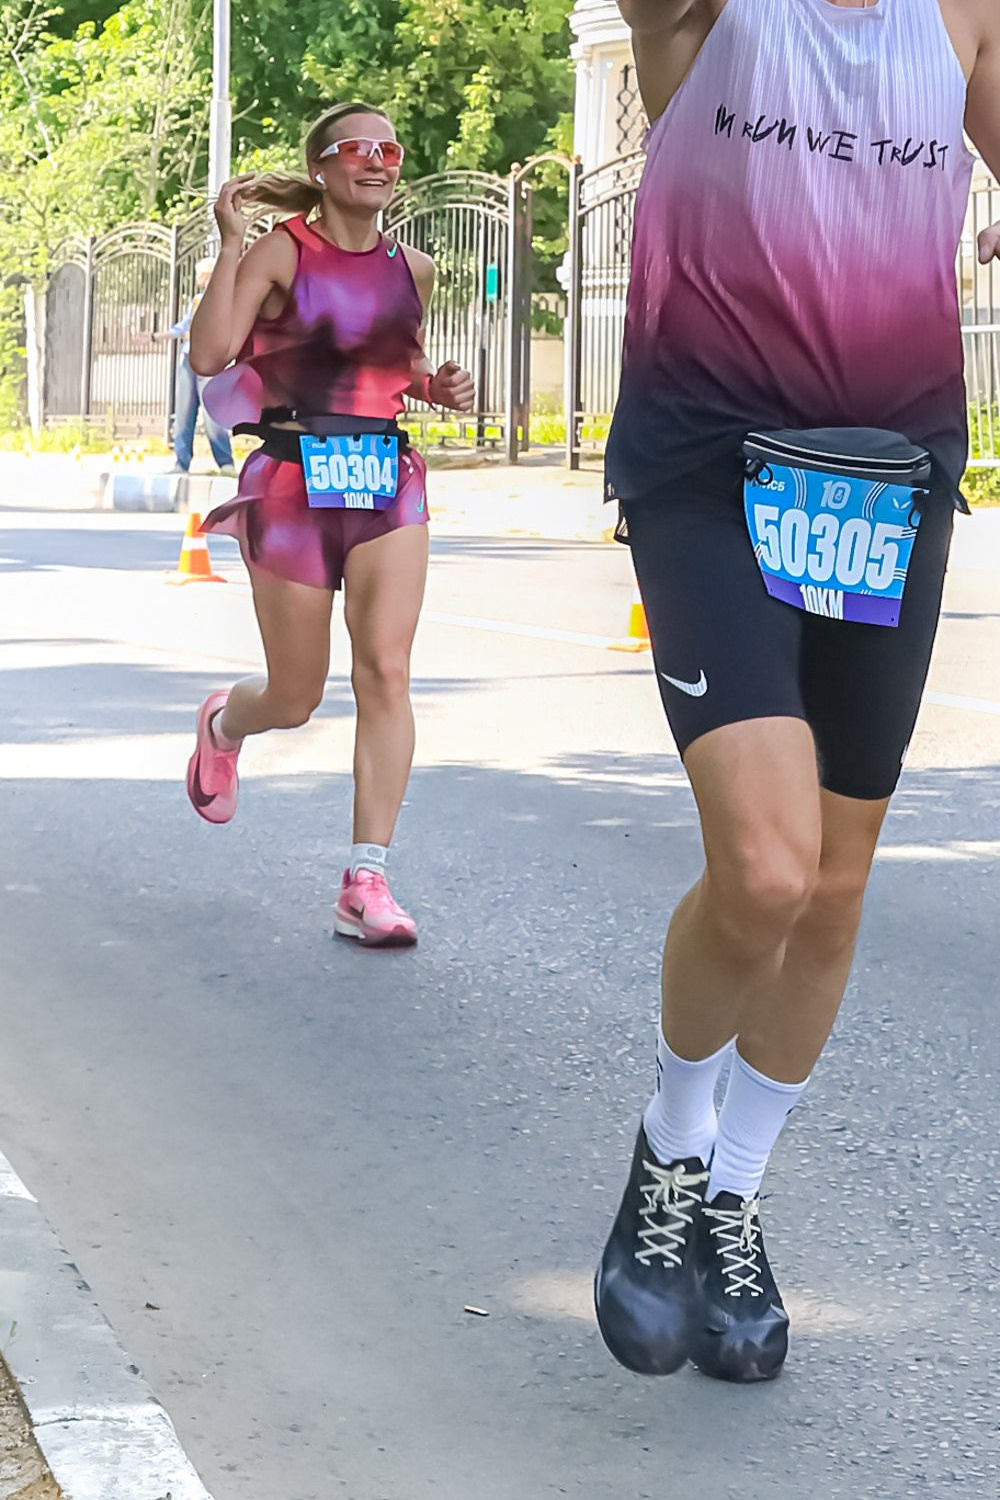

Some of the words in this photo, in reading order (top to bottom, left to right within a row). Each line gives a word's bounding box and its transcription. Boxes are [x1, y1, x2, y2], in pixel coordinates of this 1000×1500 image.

[742, 115, 797, 150] RUN
[807, 127, 858, 162] WE
[871, 138, 949, 171] TRUST
[309, 453, 395, 493] 50304
[820, 480, 851, 510] 10
[754, 503, 899, 591] 50305
